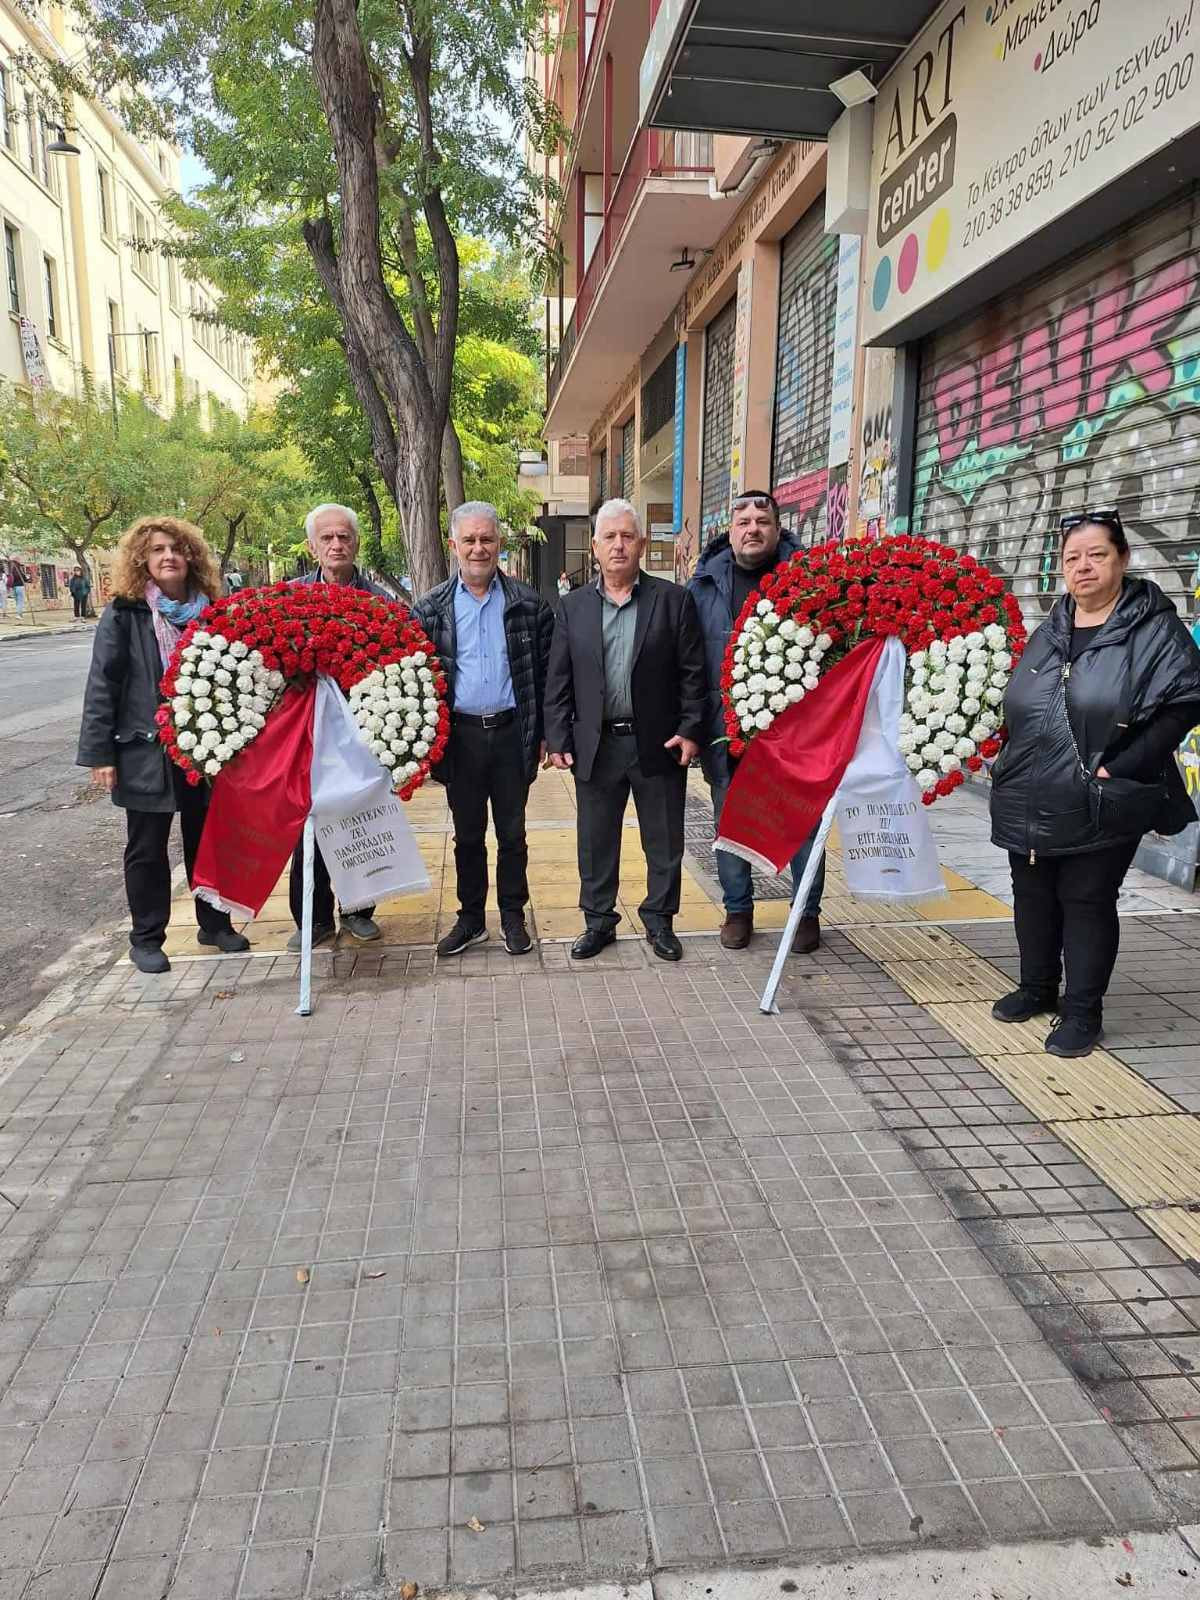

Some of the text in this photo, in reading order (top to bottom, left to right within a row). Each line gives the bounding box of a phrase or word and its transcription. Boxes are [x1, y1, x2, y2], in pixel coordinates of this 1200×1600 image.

[1041, 0, 1100, 74] Δώρα
[880, 6, 966, 176] ART
[967, 0, 1193, 209] Το Κέντρο όλων των τεχνών!
[770, 149, 797, 202] kitaab
[880, 136, 951, 233] center
[963, 51, 1194, 248] 210 38 38 859, 210 52 02 900
[846, 806, 860, 819] ΤΟ
